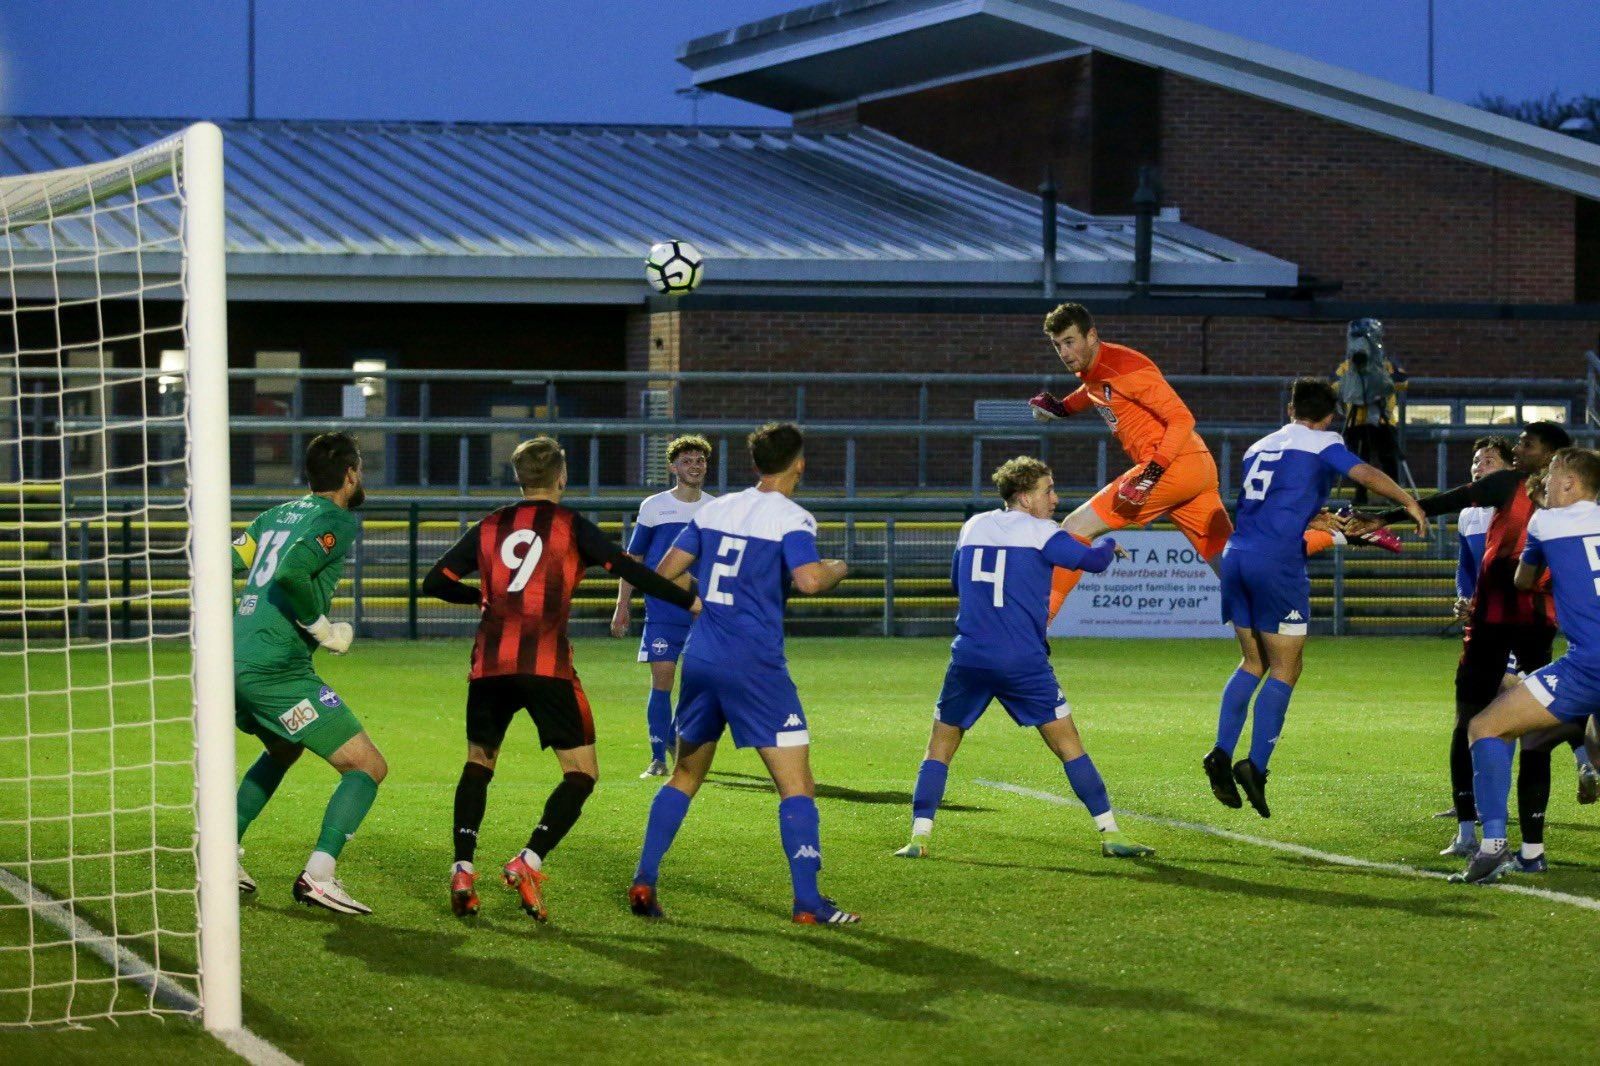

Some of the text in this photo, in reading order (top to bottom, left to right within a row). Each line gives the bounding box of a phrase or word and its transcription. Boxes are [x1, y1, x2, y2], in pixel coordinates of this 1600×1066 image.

[1243, 451, 1283, 500] 6
[247, 530, 291, 587] 13
[501, 529, 543, 592] 9
[705, 535, 748, 606] 2
[971, 548, 1006, 607] 4
[1111, 568, 1168, 578] Heartbeat
[1171, 568, 1207, 578] House
[1146, 548, 1160, 564] A
[1077, 582, 1101, 593] Help
[1104, 583, 1143, 593] support
[1146, 582, 1184, 592] families
[1187, 582, 1196, 592] in
[1092, 594, 1133, 608] £240
[1138, 597, 1163, 610] per
